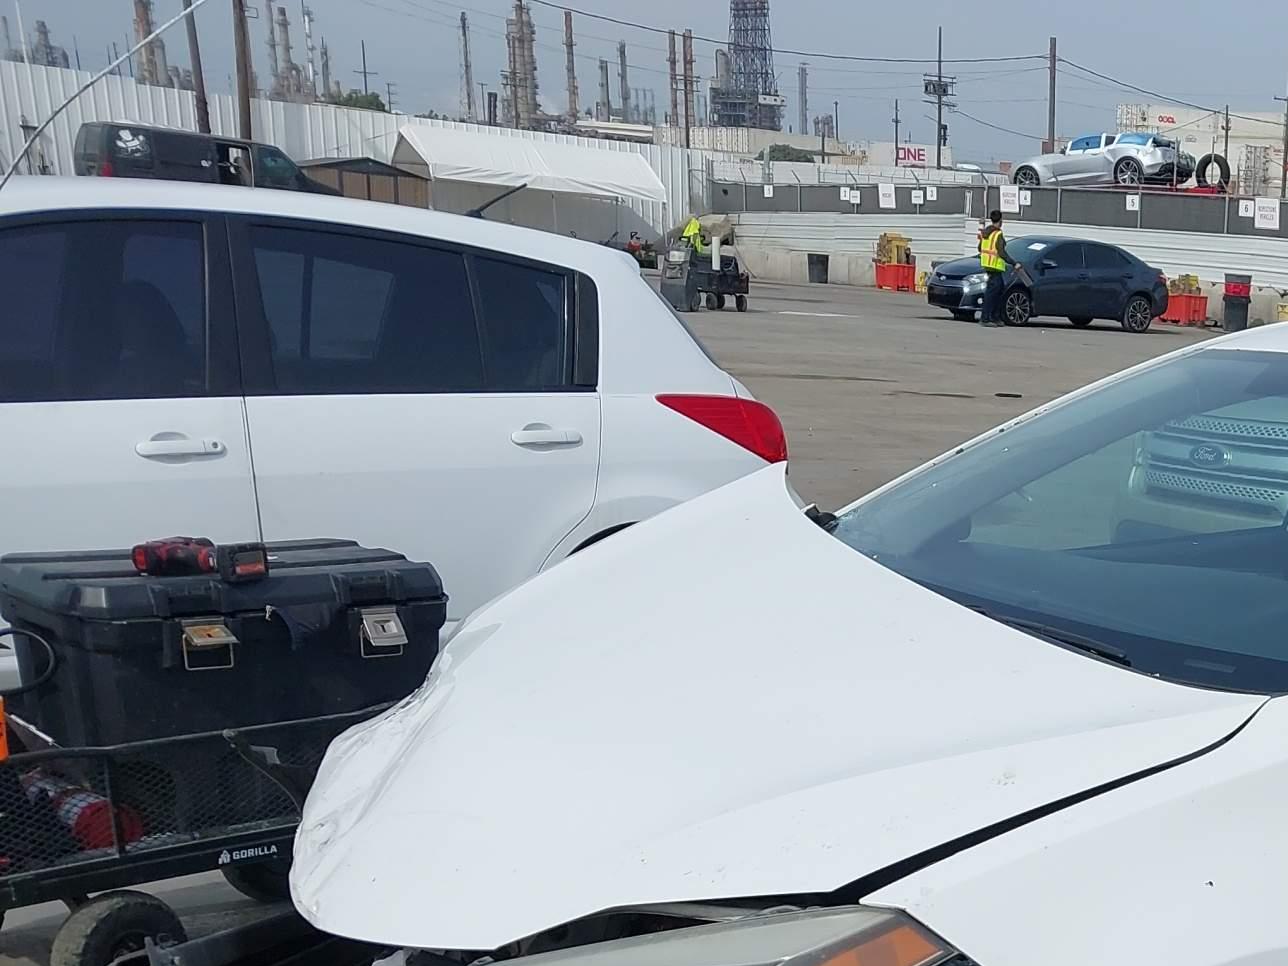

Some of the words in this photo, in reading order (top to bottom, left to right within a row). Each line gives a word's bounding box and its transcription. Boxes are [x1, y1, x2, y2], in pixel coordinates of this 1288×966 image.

[895, 147, 926, 161] ONE
[1244, 204, 1249, 213] 6
[1194, 446, 1217, 461] Ford
[232, 844, 278, 860] GORILLA
